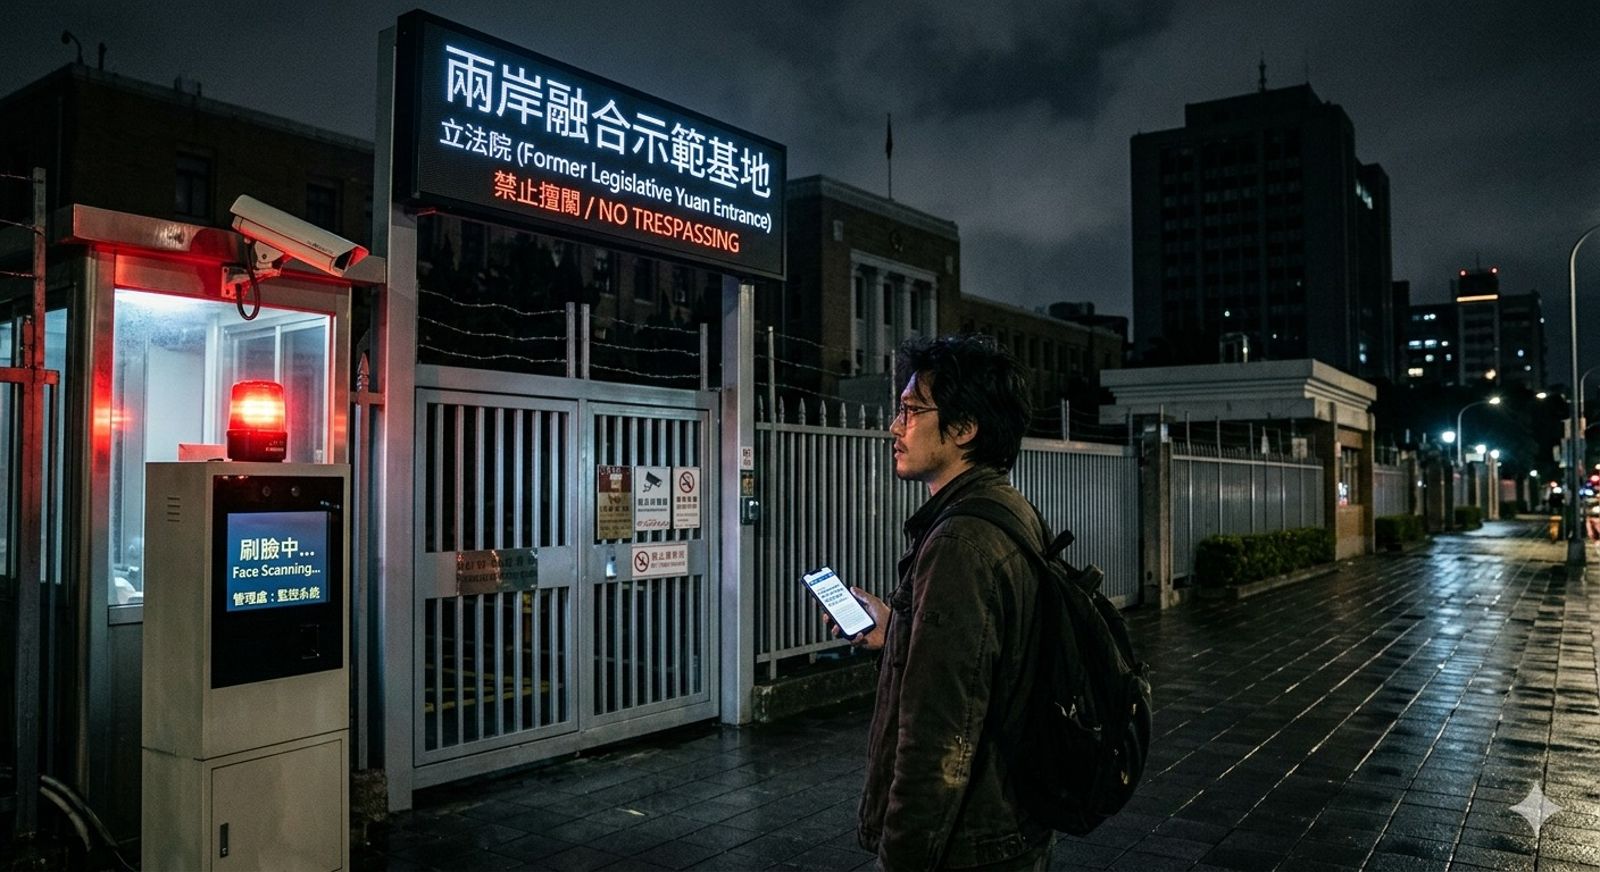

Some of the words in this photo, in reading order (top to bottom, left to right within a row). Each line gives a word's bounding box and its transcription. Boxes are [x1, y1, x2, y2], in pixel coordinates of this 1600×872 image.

[446, 45, 771, 199] 兩岸融合示範基地
[440, 118, 512, 161] 立法院
[517, 142, 587, 179] (Former
[591, 161, 672, 202] Legislative
[675, 186, 710, 213] Yuan
[714, 197, 772, 233] Entrance)
[584, 196, 595, 220] /
[599, 198, 628, 225] NO
[632, 207, 740, 253] TRESPASSING
[233, 566, 259, 578] Face
[261, 563, 321, 576] Scanning...
